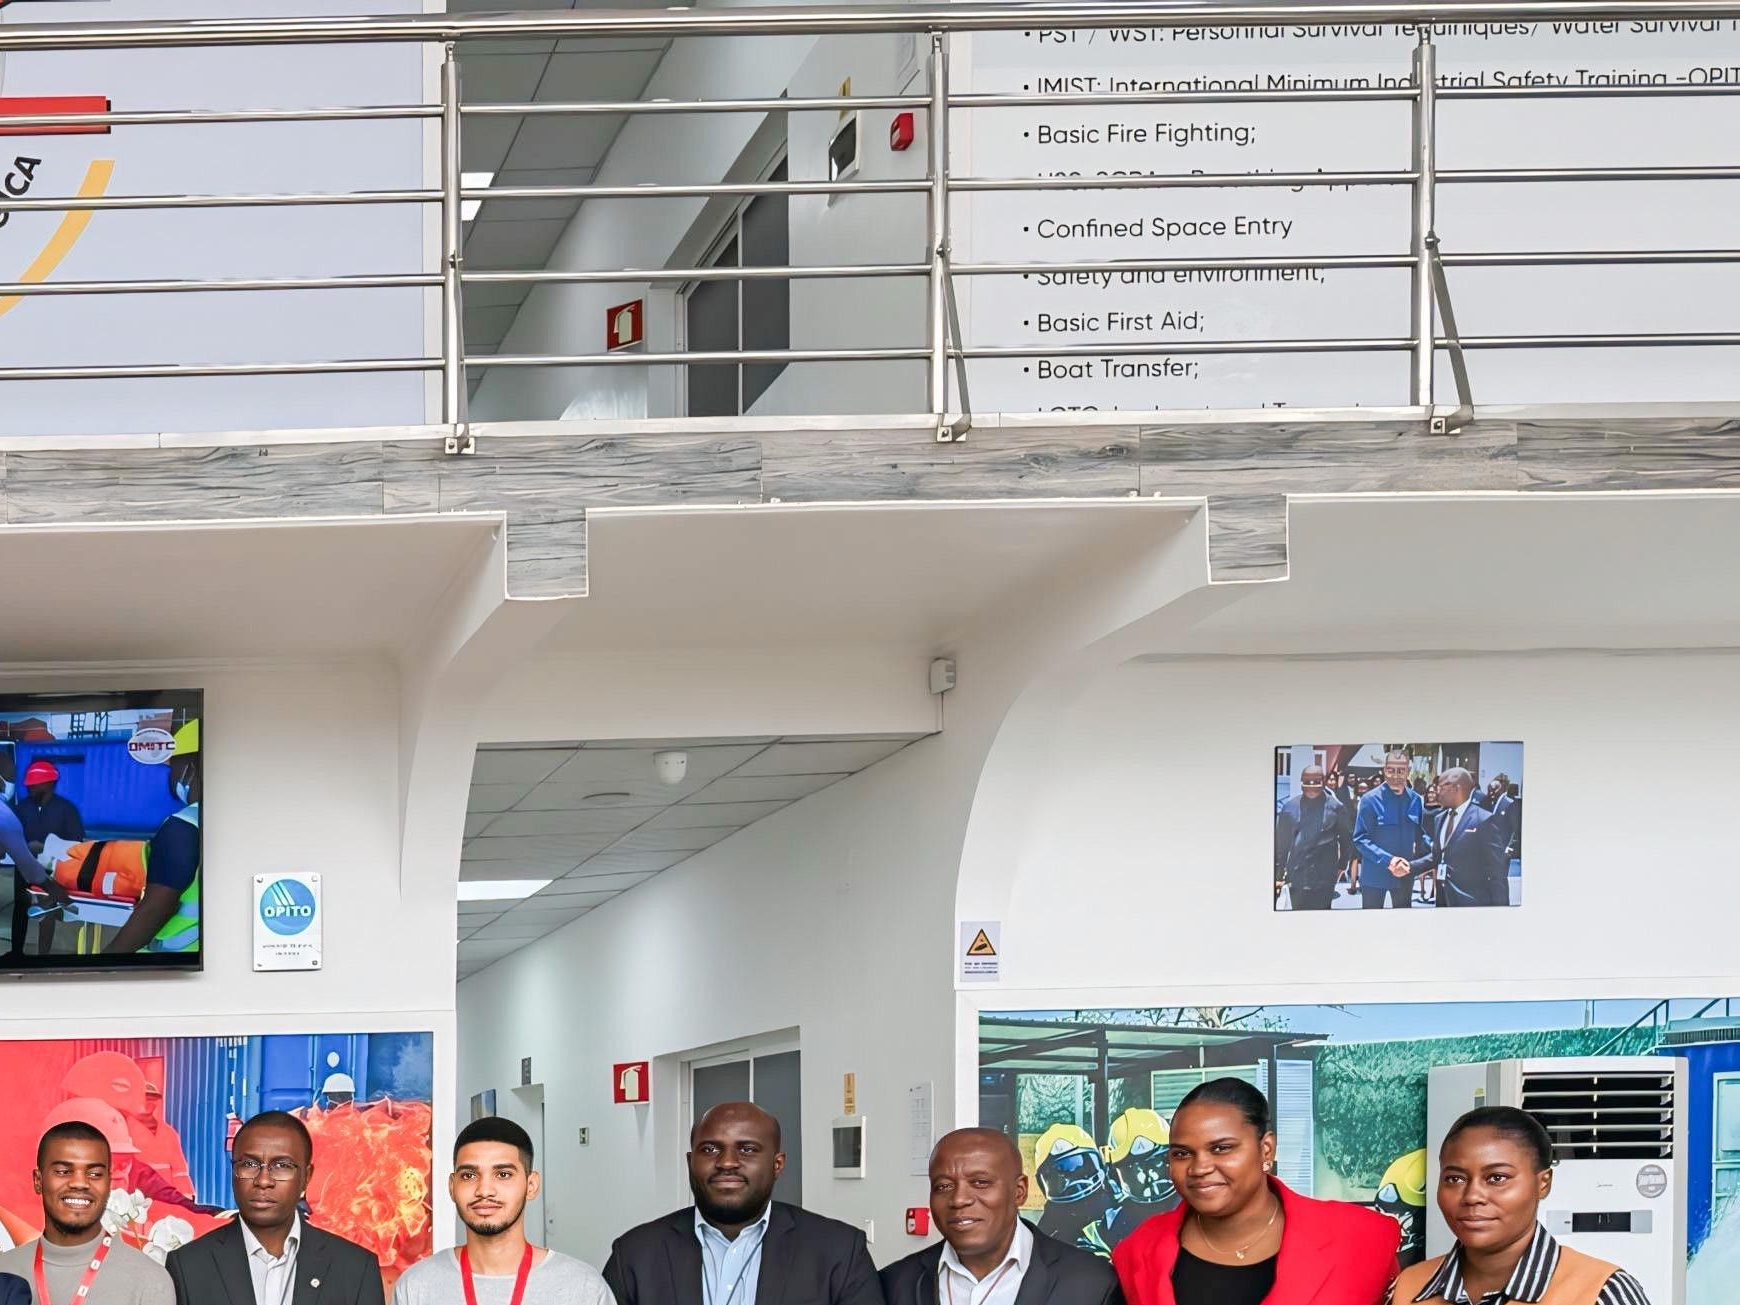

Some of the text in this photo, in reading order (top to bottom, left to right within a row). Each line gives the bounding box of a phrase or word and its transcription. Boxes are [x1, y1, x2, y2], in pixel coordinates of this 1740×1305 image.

[1109, 74, 1258, 92] International
[1267, 73, 1370, 91] Minimum
[1037, 122, 1256, 147] Basic Fire Fighting;
[1037, 216, 1293, 241] Confined Space Entry
[1037, 310, 1205, 333] Basic First Aid;
[1037, 356, 1199, 380] Boat Transfer;
[264, 904, 312, 918] OPITO
